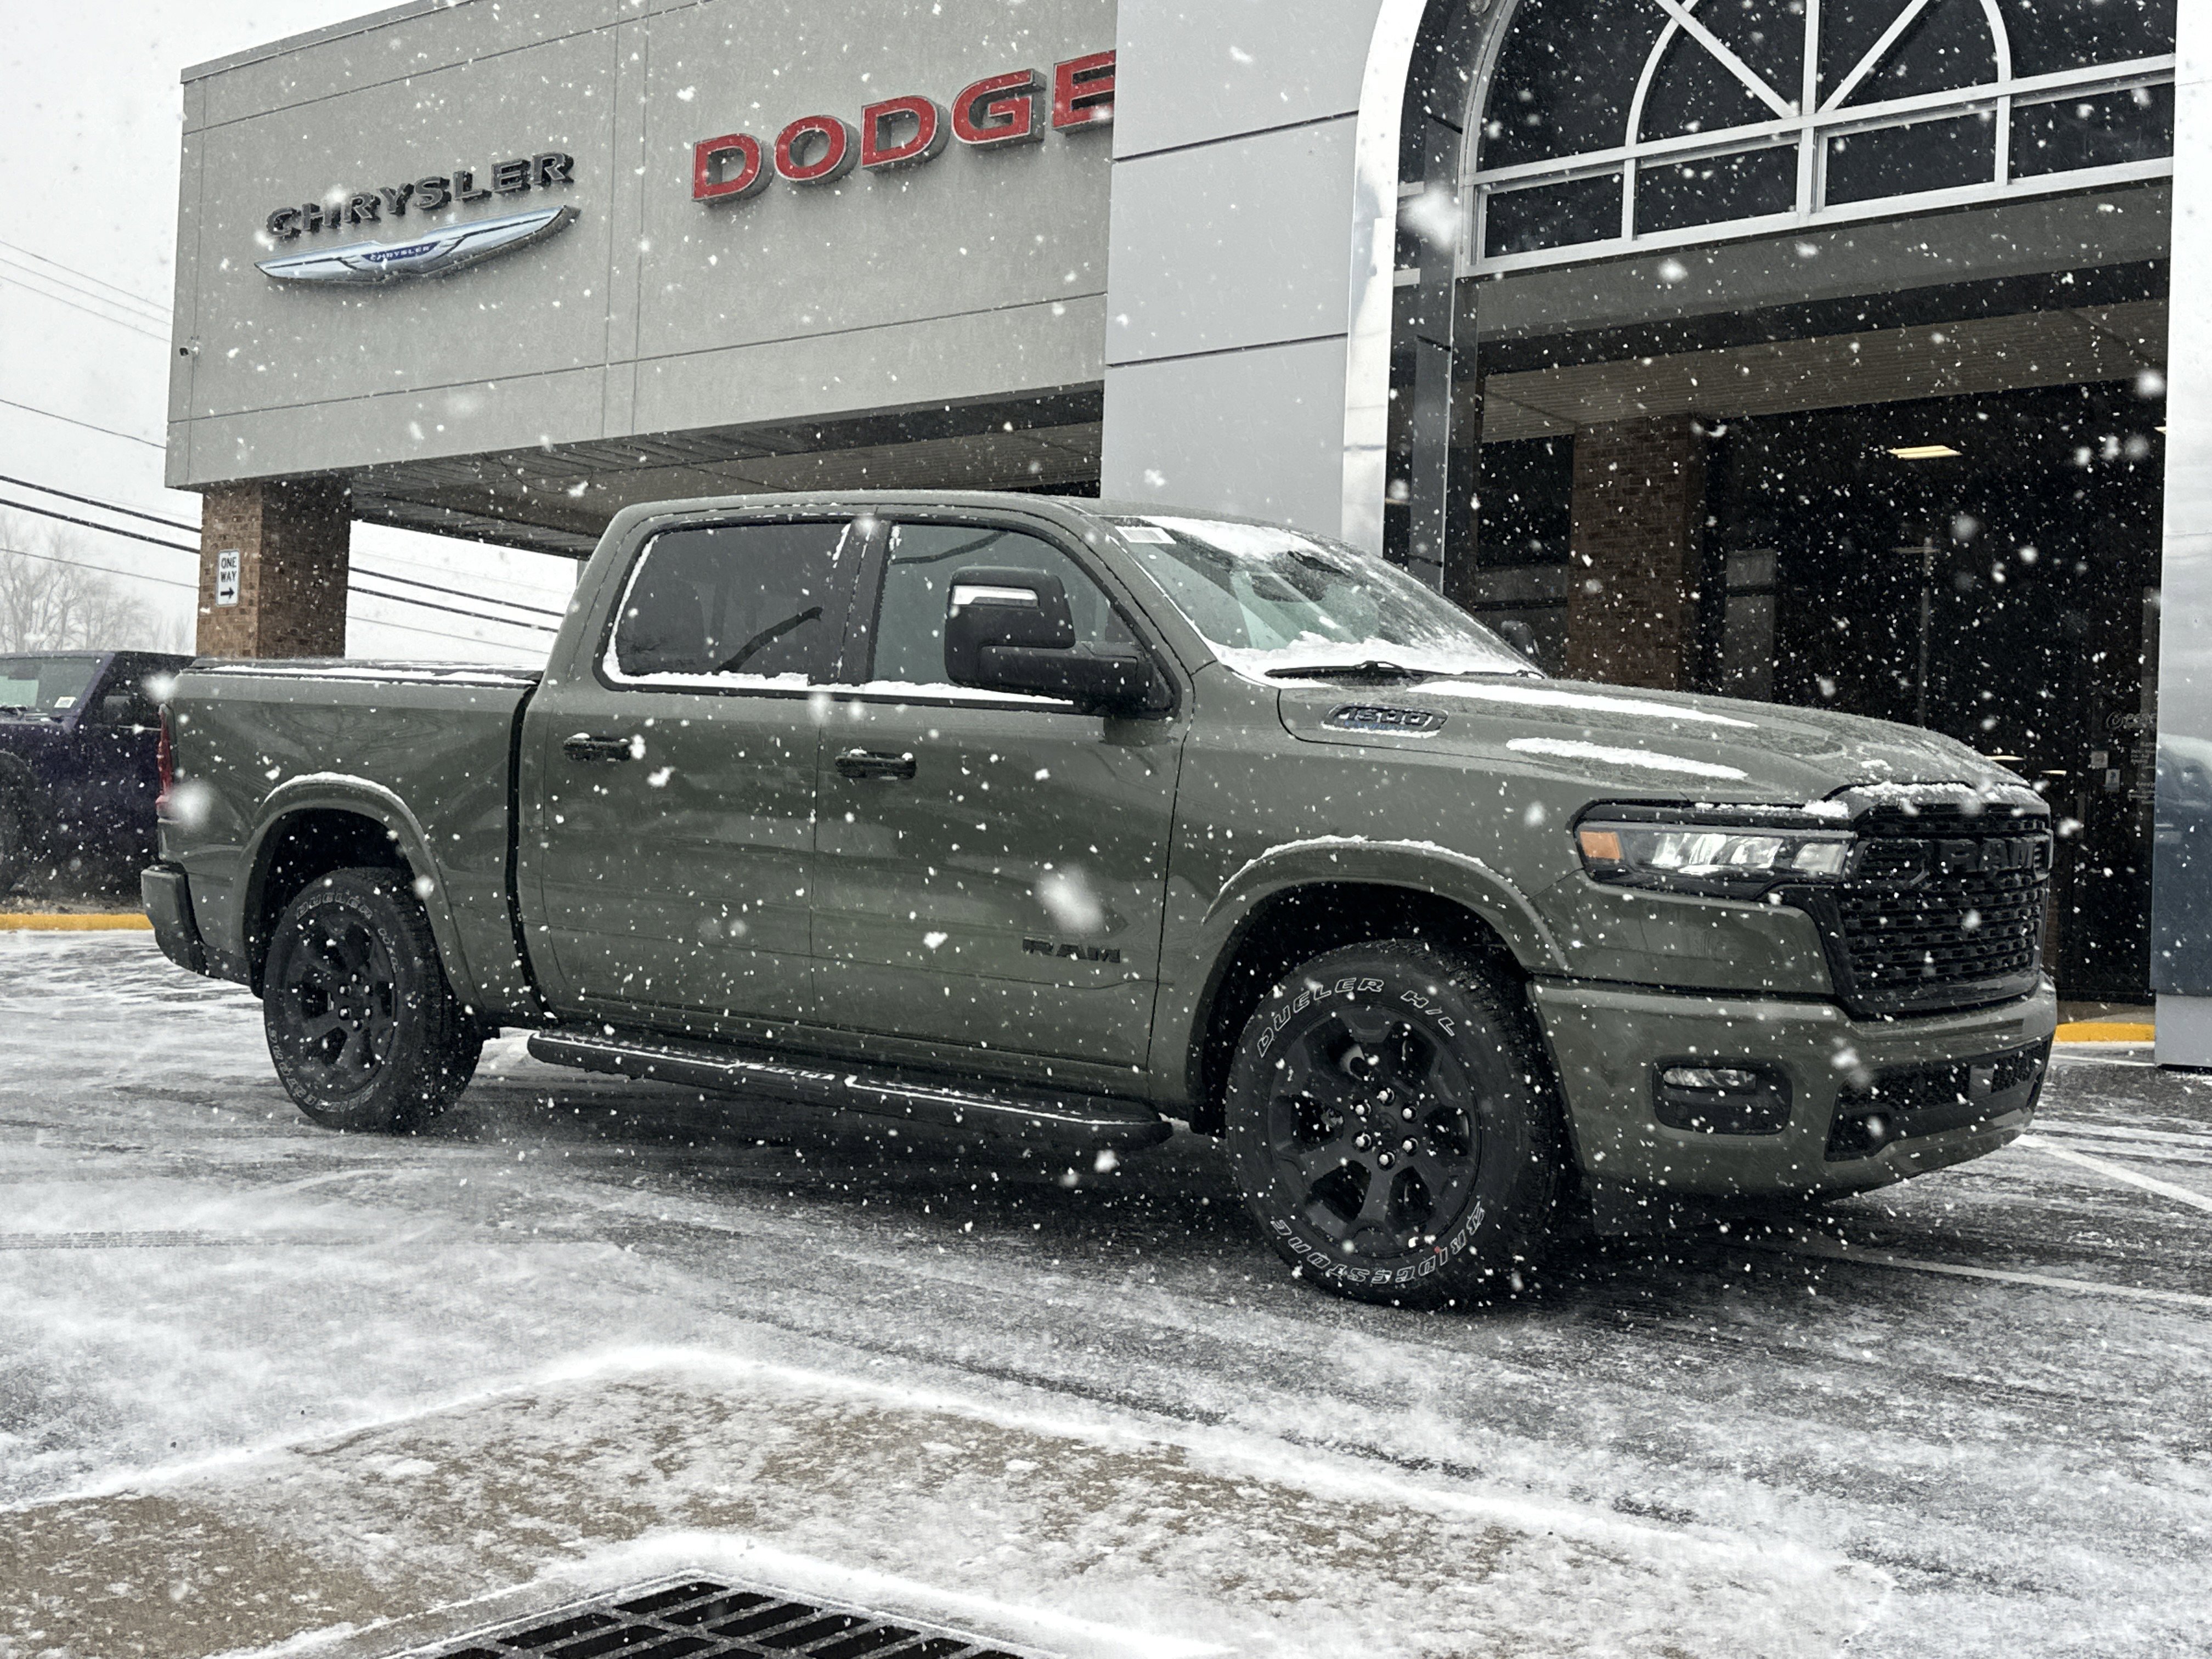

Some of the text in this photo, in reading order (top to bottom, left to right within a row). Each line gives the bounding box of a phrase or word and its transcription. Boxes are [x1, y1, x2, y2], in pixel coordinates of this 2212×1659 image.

[691, 49, 1116, 205] DODGE
[266, 151, 574, 239] CHRYSLER
[370, 245, 430, 261] CHRYSLER
[221, 556, 237, 569] ONE
[221, 571, 237, 583] WAY
[1347, 707, 1430, 726] 1500
[1022, 936, 1121, 964] RAM
[1256, 977, 1457, 1058] DUELER H/L
[1271, 1200, 1487, 1285] BRIDGESTONE
